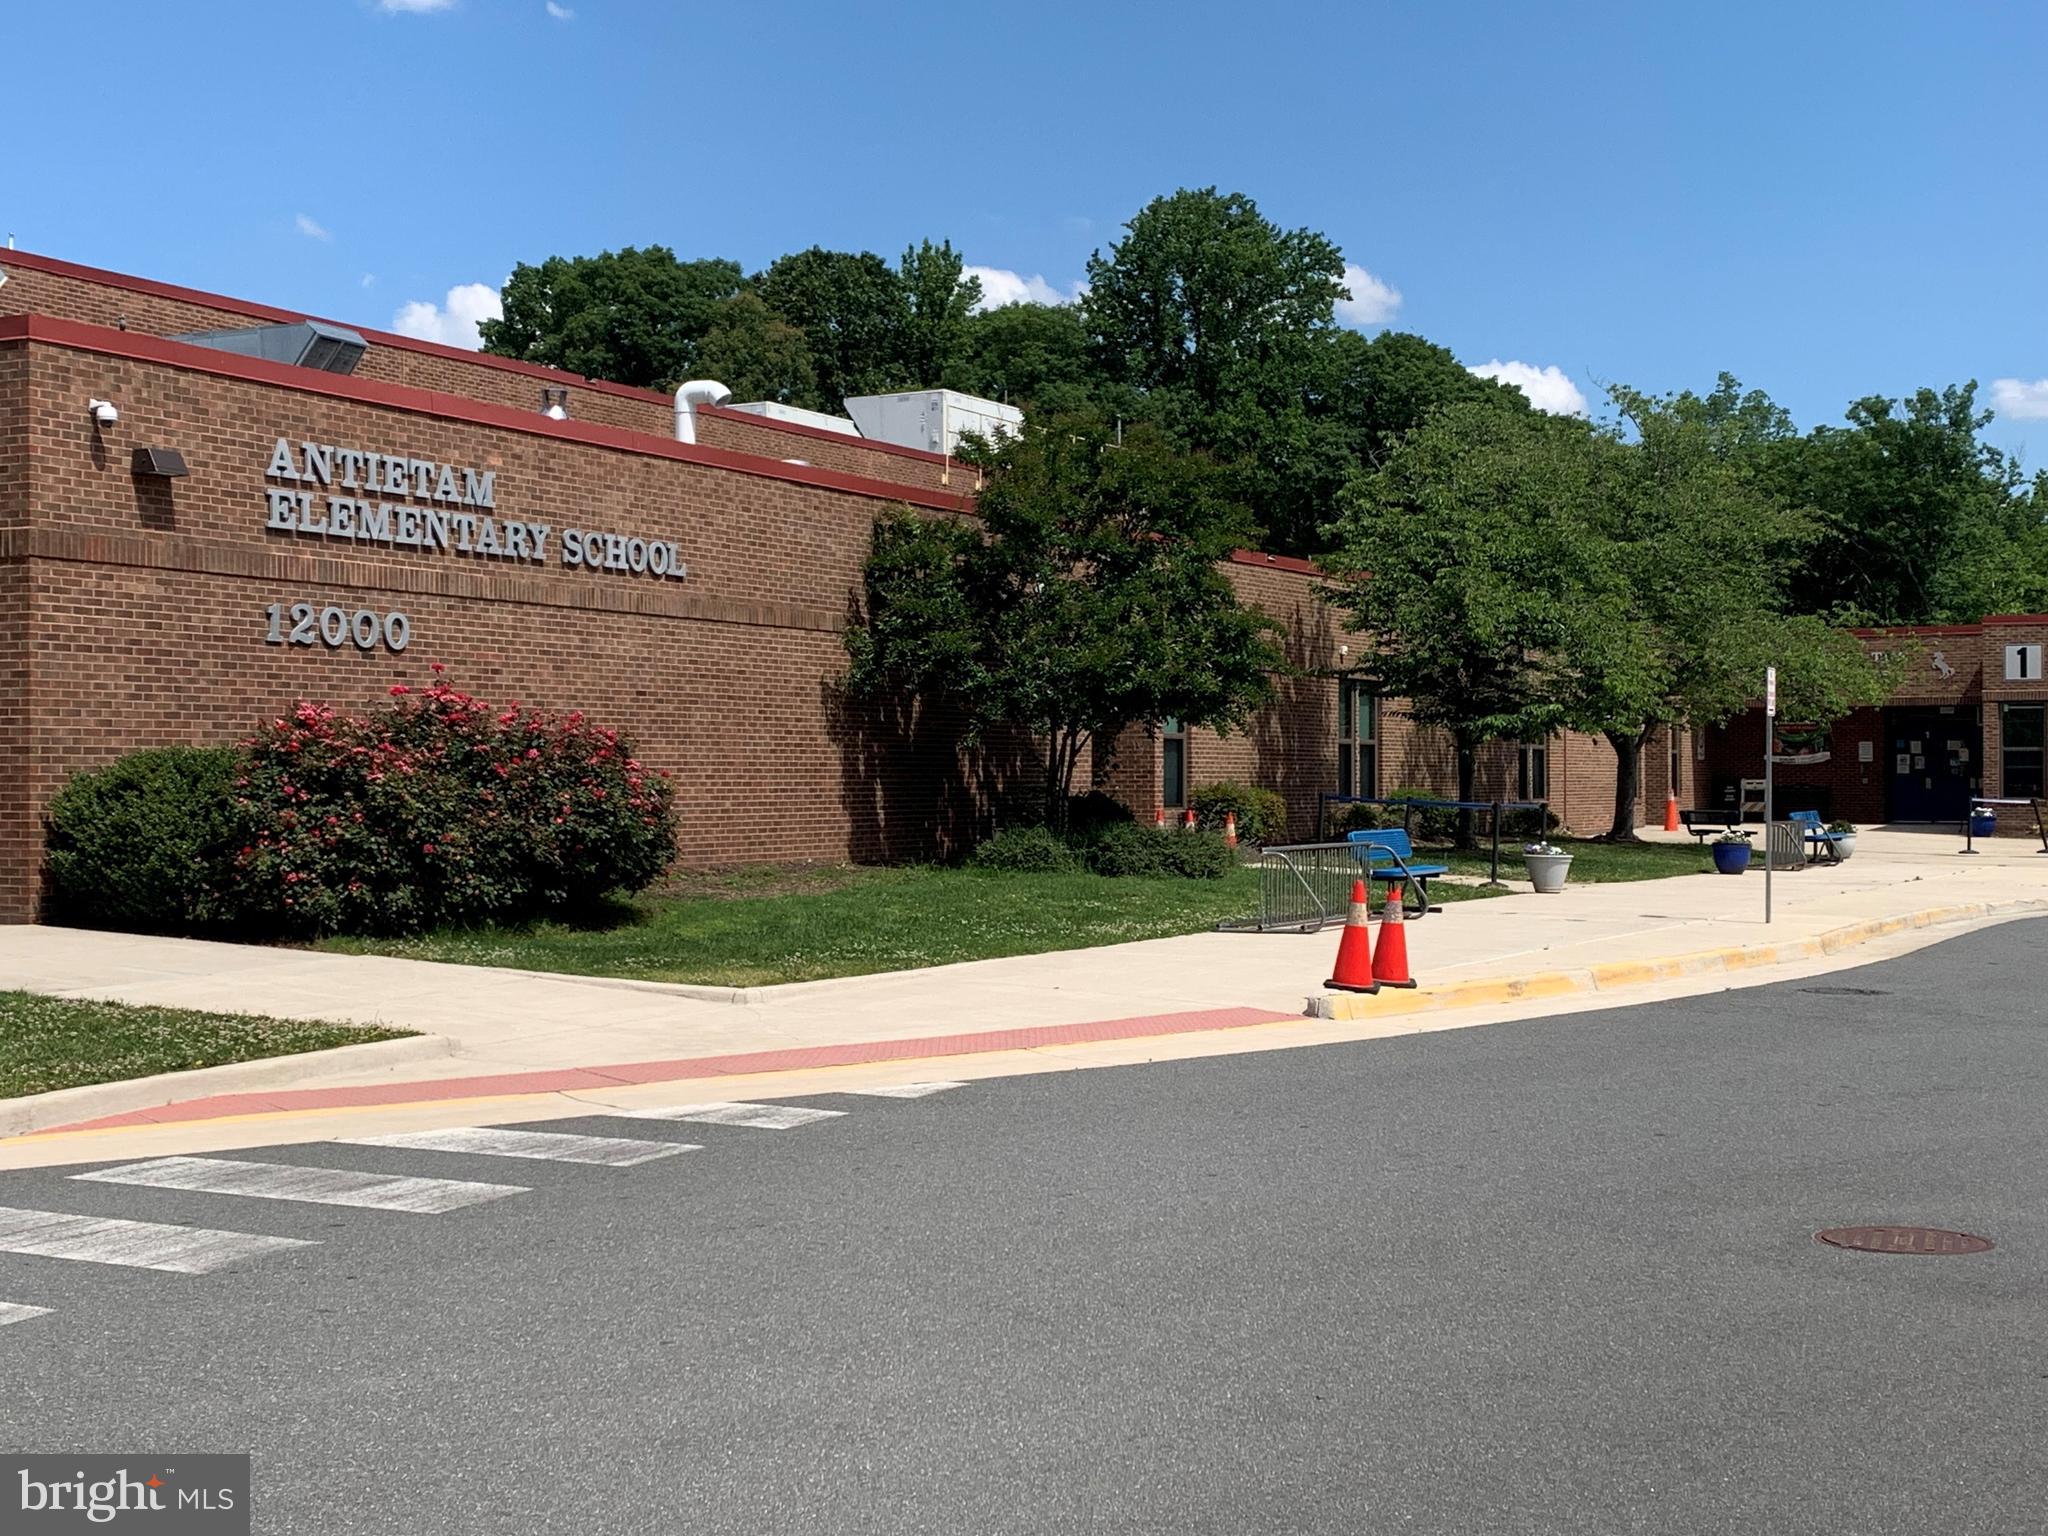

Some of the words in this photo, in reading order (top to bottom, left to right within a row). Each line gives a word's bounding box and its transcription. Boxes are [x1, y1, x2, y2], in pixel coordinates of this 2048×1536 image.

[265, 438, 496, 508] ANTIETAM
[265, 488, 551, 560] ELEMENTARY
[562, 528, 687, 578] SCHOOL
[265, 602, 411, 651] 12000
[2017, 647, 2027, 678] 1
